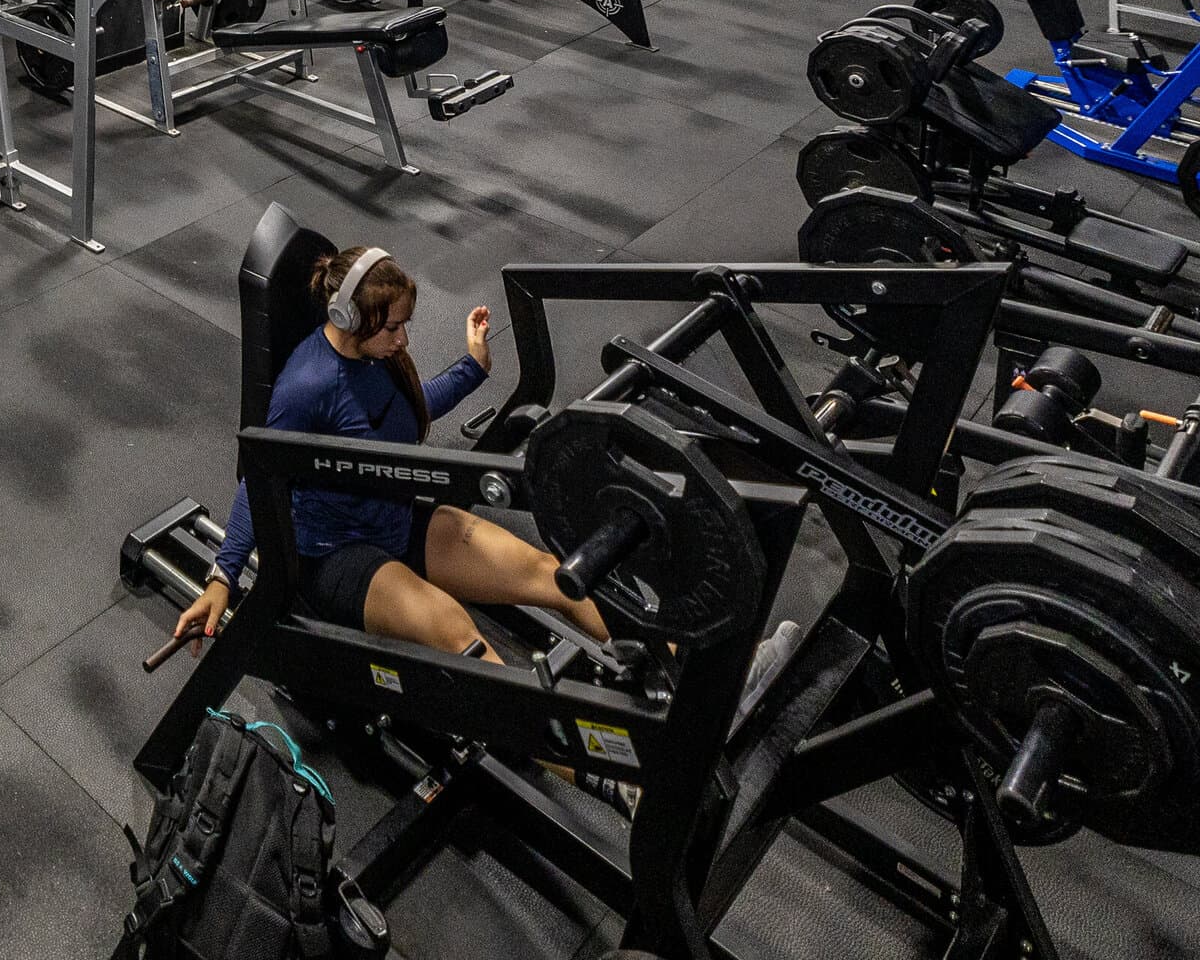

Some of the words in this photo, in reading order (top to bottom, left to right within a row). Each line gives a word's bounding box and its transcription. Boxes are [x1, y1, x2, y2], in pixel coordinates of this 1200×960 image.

[314, 457, 353, 472] HP
[358, 462, 451, 485] PRESS
[796, 460, 942, 541] Pendulu
